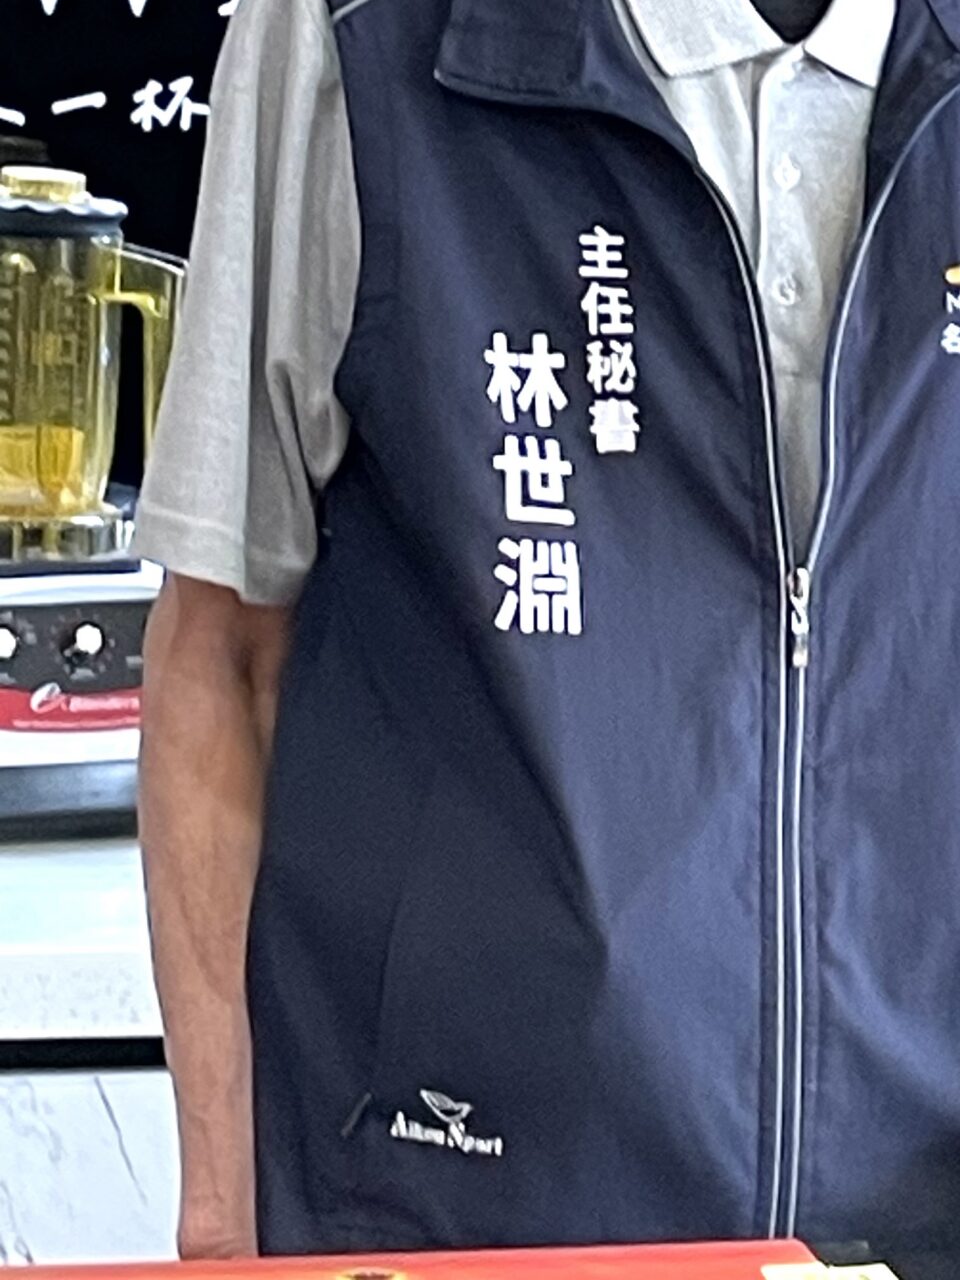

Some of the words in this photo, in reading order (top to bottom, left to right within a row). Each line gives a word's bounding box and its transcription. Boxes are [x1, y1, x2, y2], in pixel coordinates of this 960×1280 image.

[578, 225, 640, 454] 主任秘書
[484, 332, 583, 636] 林世淵
